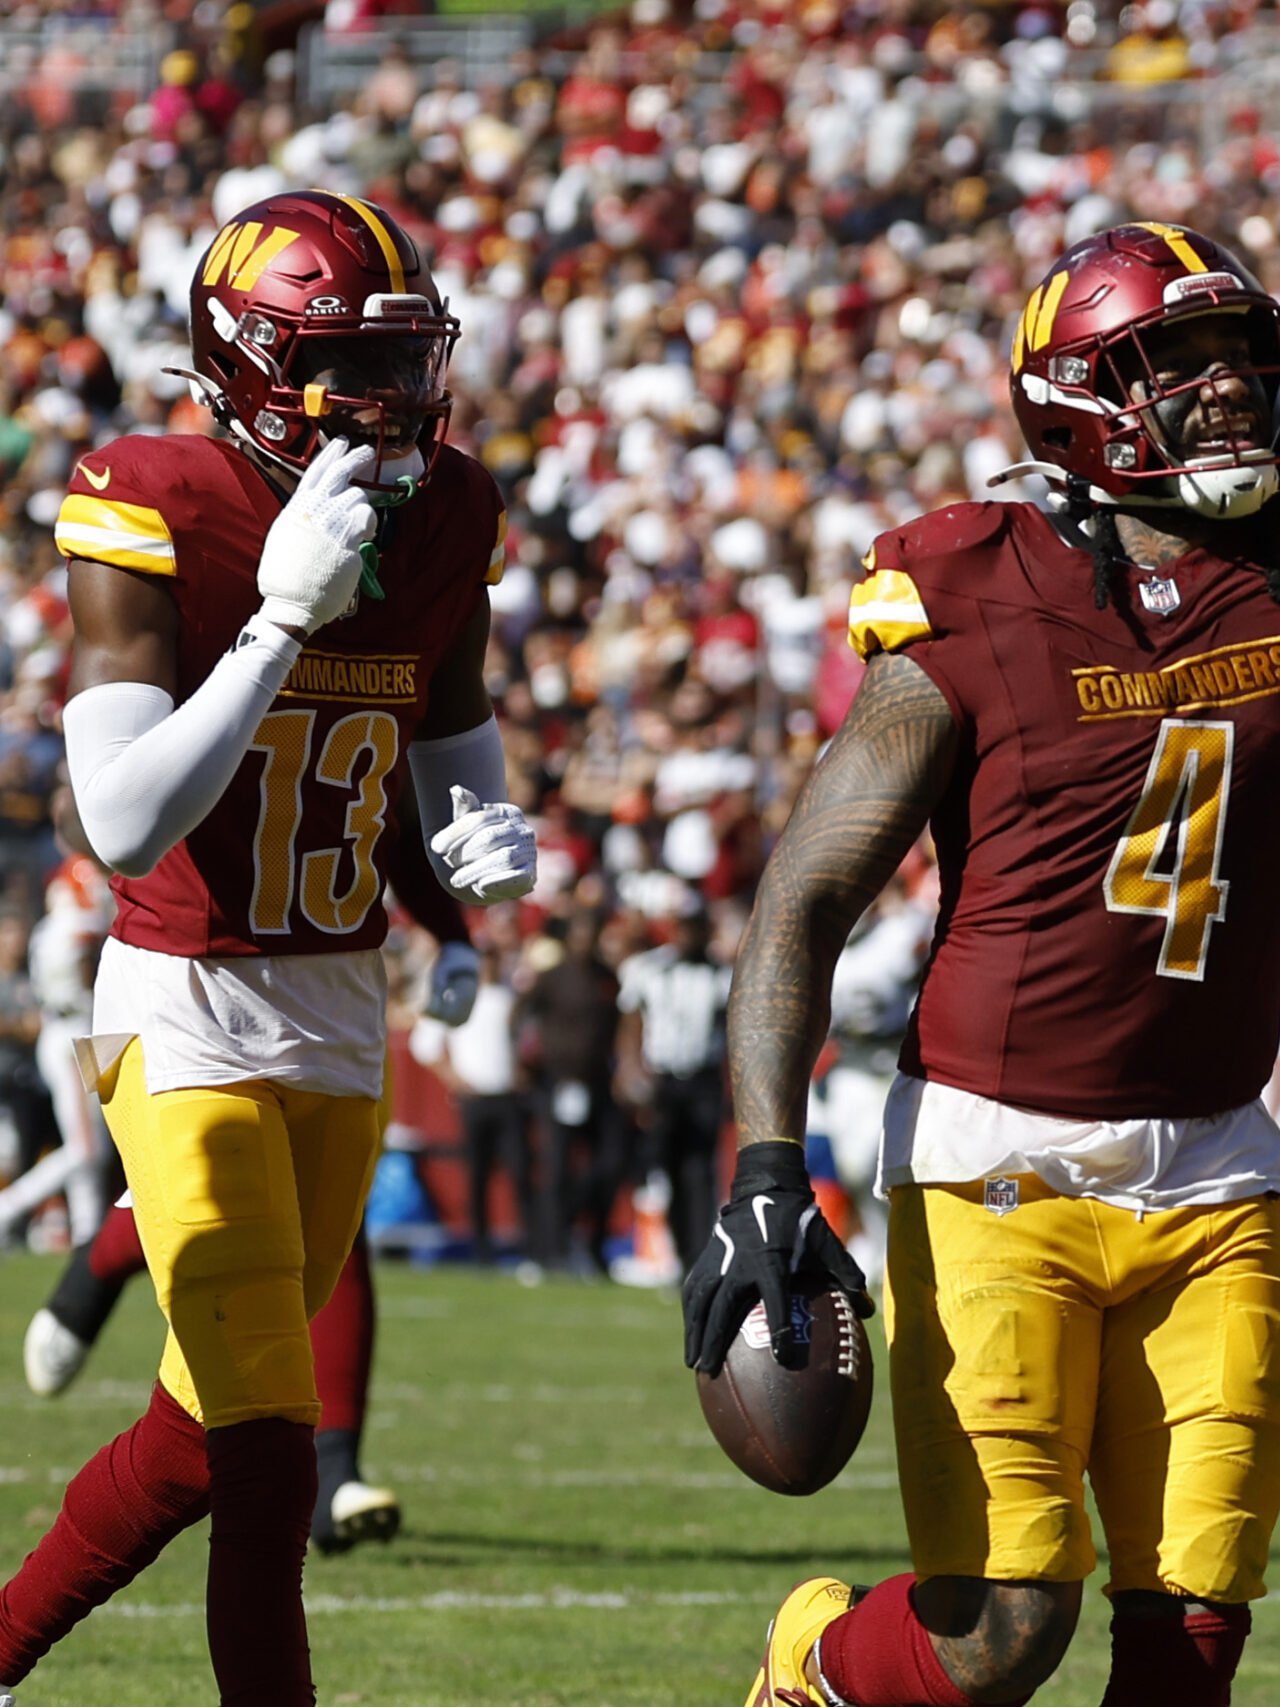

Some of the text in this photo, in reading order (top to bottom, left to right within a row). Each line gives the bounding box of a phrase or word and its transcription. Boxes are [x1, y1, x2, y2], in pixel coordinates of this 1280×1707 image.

[305, 306, 349, 316] OAKLEY
[283, 657, 416, 695] MMANDERS
[245, 709, 400, 935] 13
[1103, 717, 1235, 983] 4
[988, 1191, 1014, 1207] NFL
